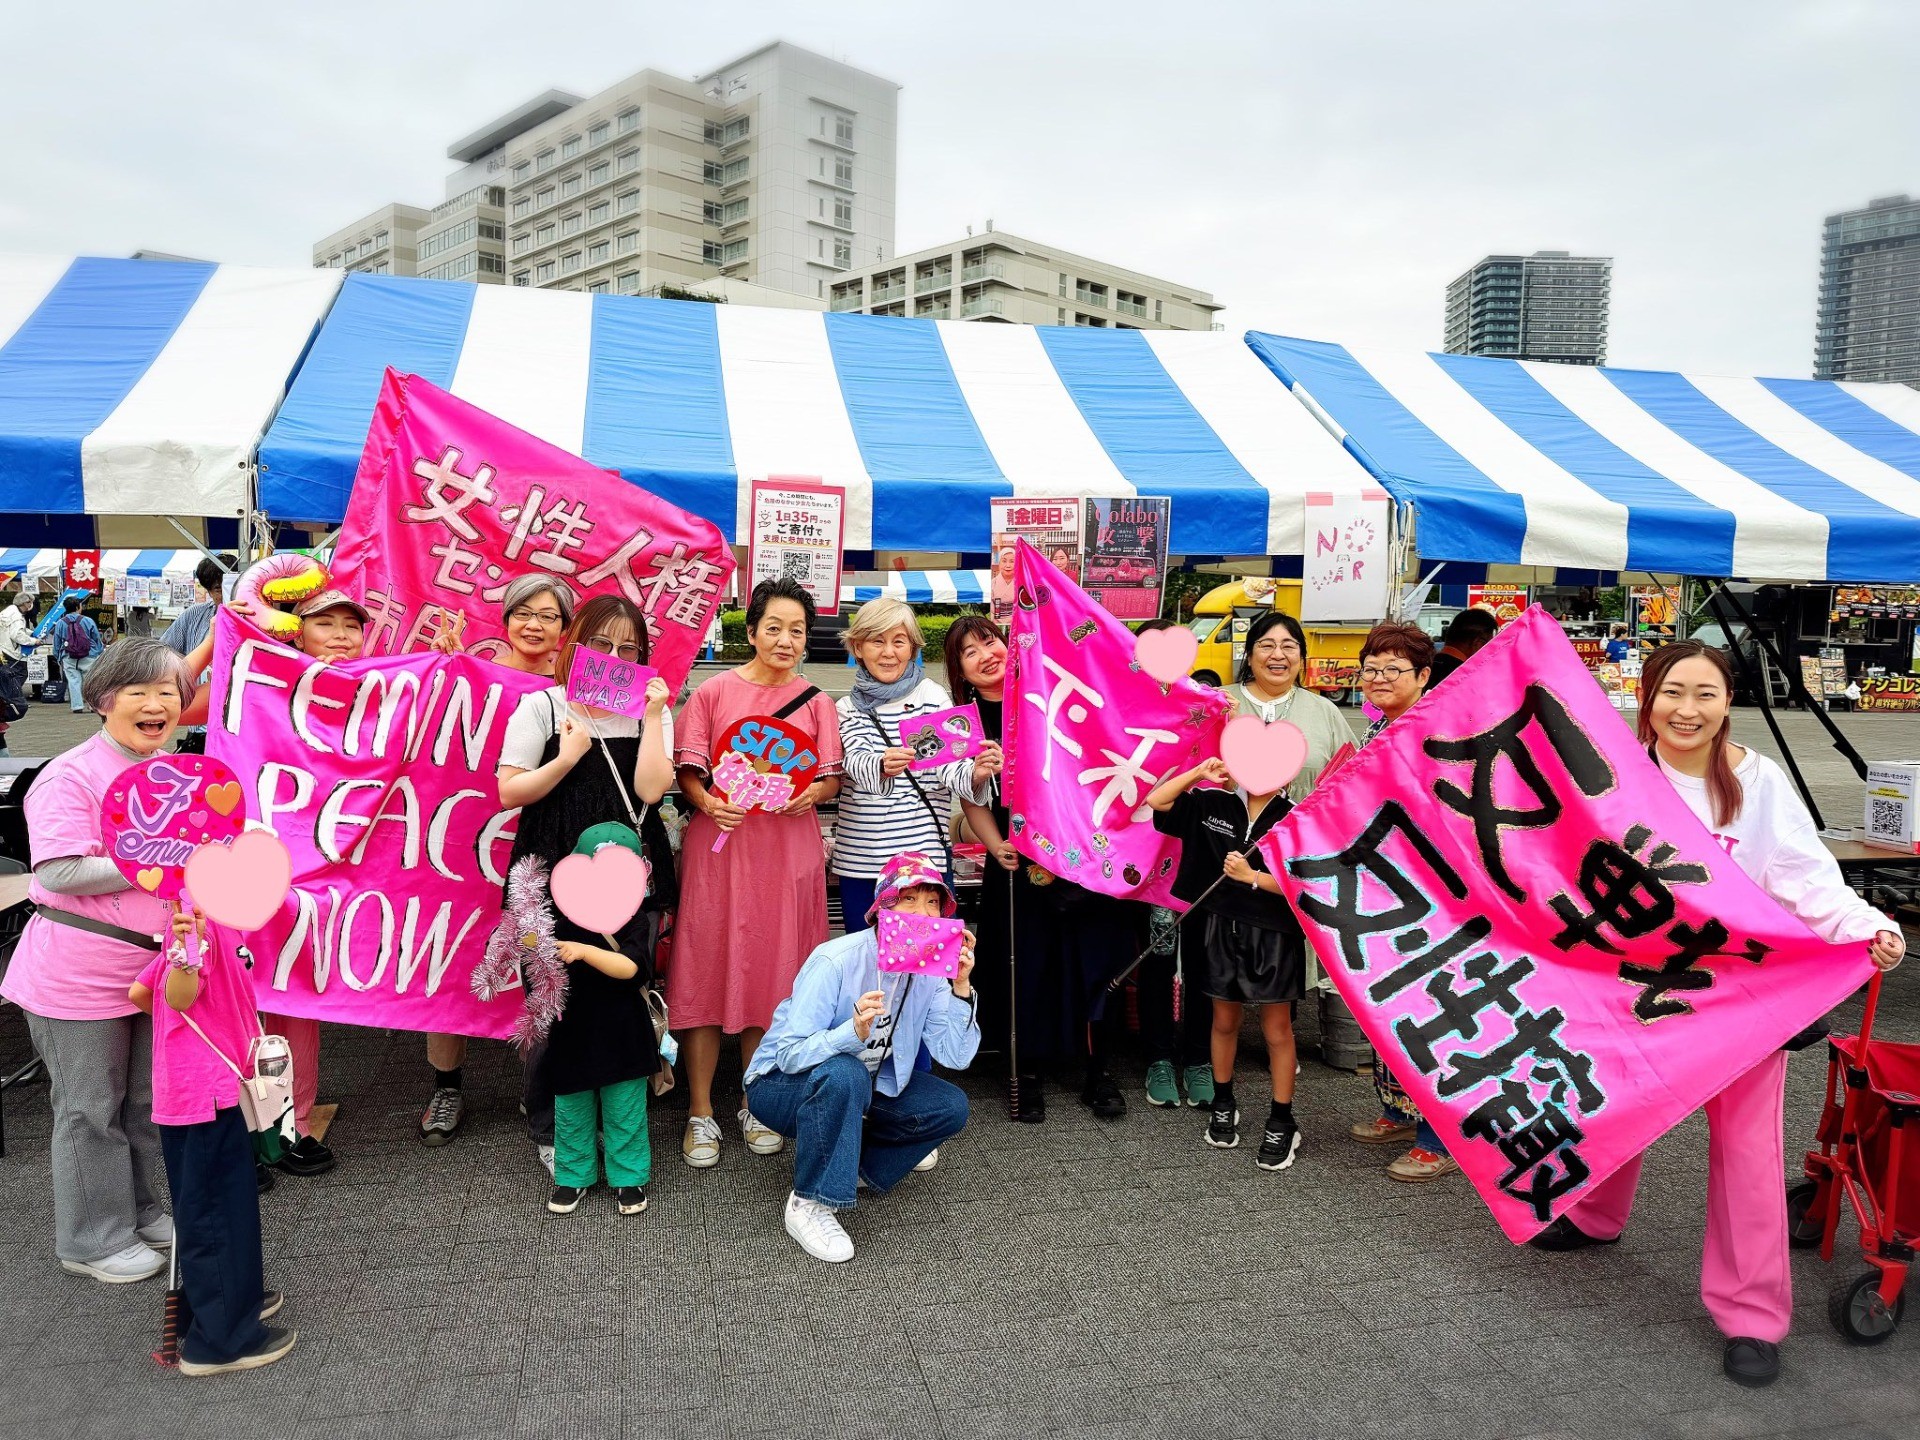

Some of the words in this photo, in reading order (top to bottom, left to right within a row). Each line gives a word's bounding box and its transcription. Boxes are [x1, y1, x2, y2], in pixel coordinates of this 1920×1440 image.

[775, 510, 831, 524] 1日35円からの
[1014, 508, 1062, 525] 金曜日
[1095, 505, 1159, 524] Colabo
[398, 445, 724, 631] 女性人権
[762, 534, 832, 545] 支援に参加できます
[777, 523, 822, 536] ご寄付で
[1316, 517, 1375, 558] NO
[70, 549, 96, 582] 教
[1482, 595, 1515, 603] レオケバブ
[1572, 643, 1598, 652] EBA
[1579, 655, 1607, 666] ケバブ
[223, 638, 527, 775] FEMIN
[574, 678, 631, 711] WAR
[731, 720, 817, 774] STOP
[257, 760, 523, 888] PEACE
[271, 885, 485, 998] NOW
